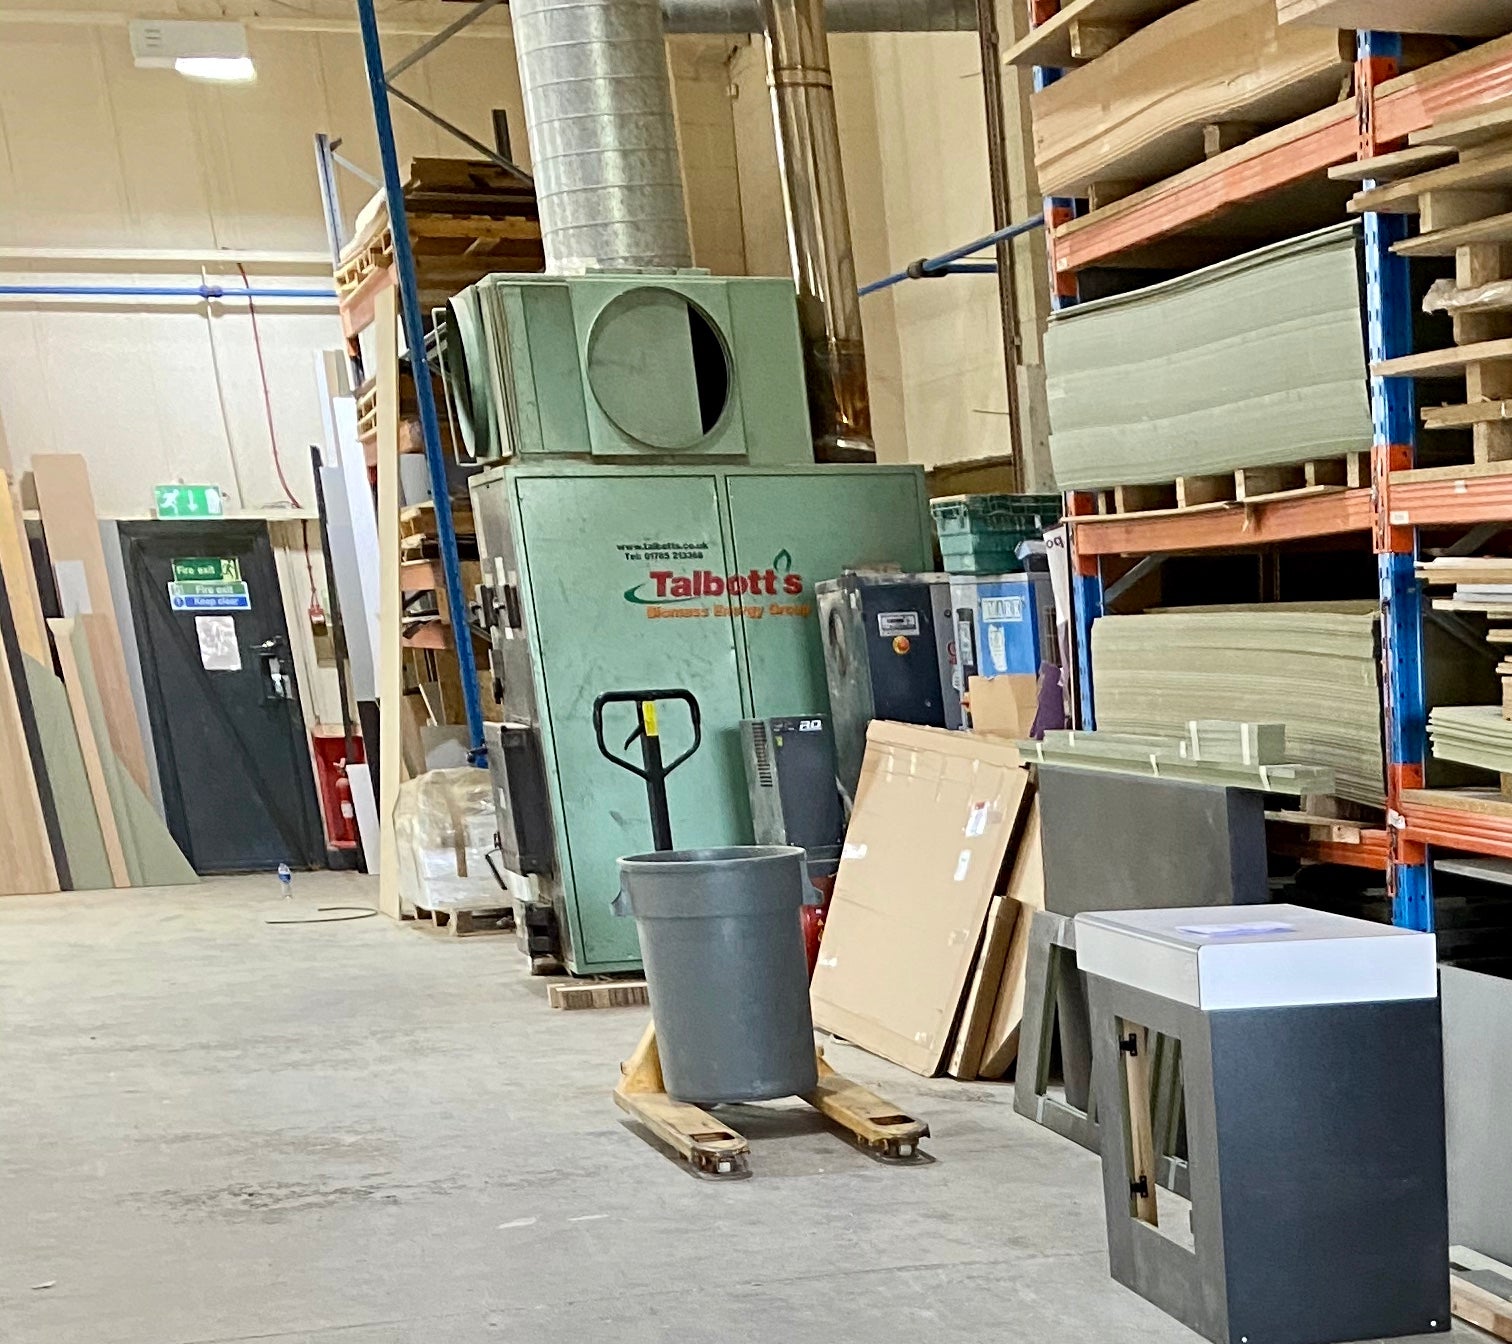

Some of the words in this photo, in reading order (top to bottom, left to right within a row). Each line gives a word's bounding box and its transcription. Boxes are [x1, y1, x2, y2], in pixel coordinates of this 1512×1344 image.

[176, 565, 195, 575] Fire
[197, 565, 215, 574] exit
[195, 585, 214, 594] Fire
[216, 585, 234, 594] exit
[194, 597, 216, 607] Keep
[217, 598, 239, 606] clear
[646, 605, 710, 619] Biomass
[713, 604, 763, 619] Energy
[769, 603, 811, 618] Group
